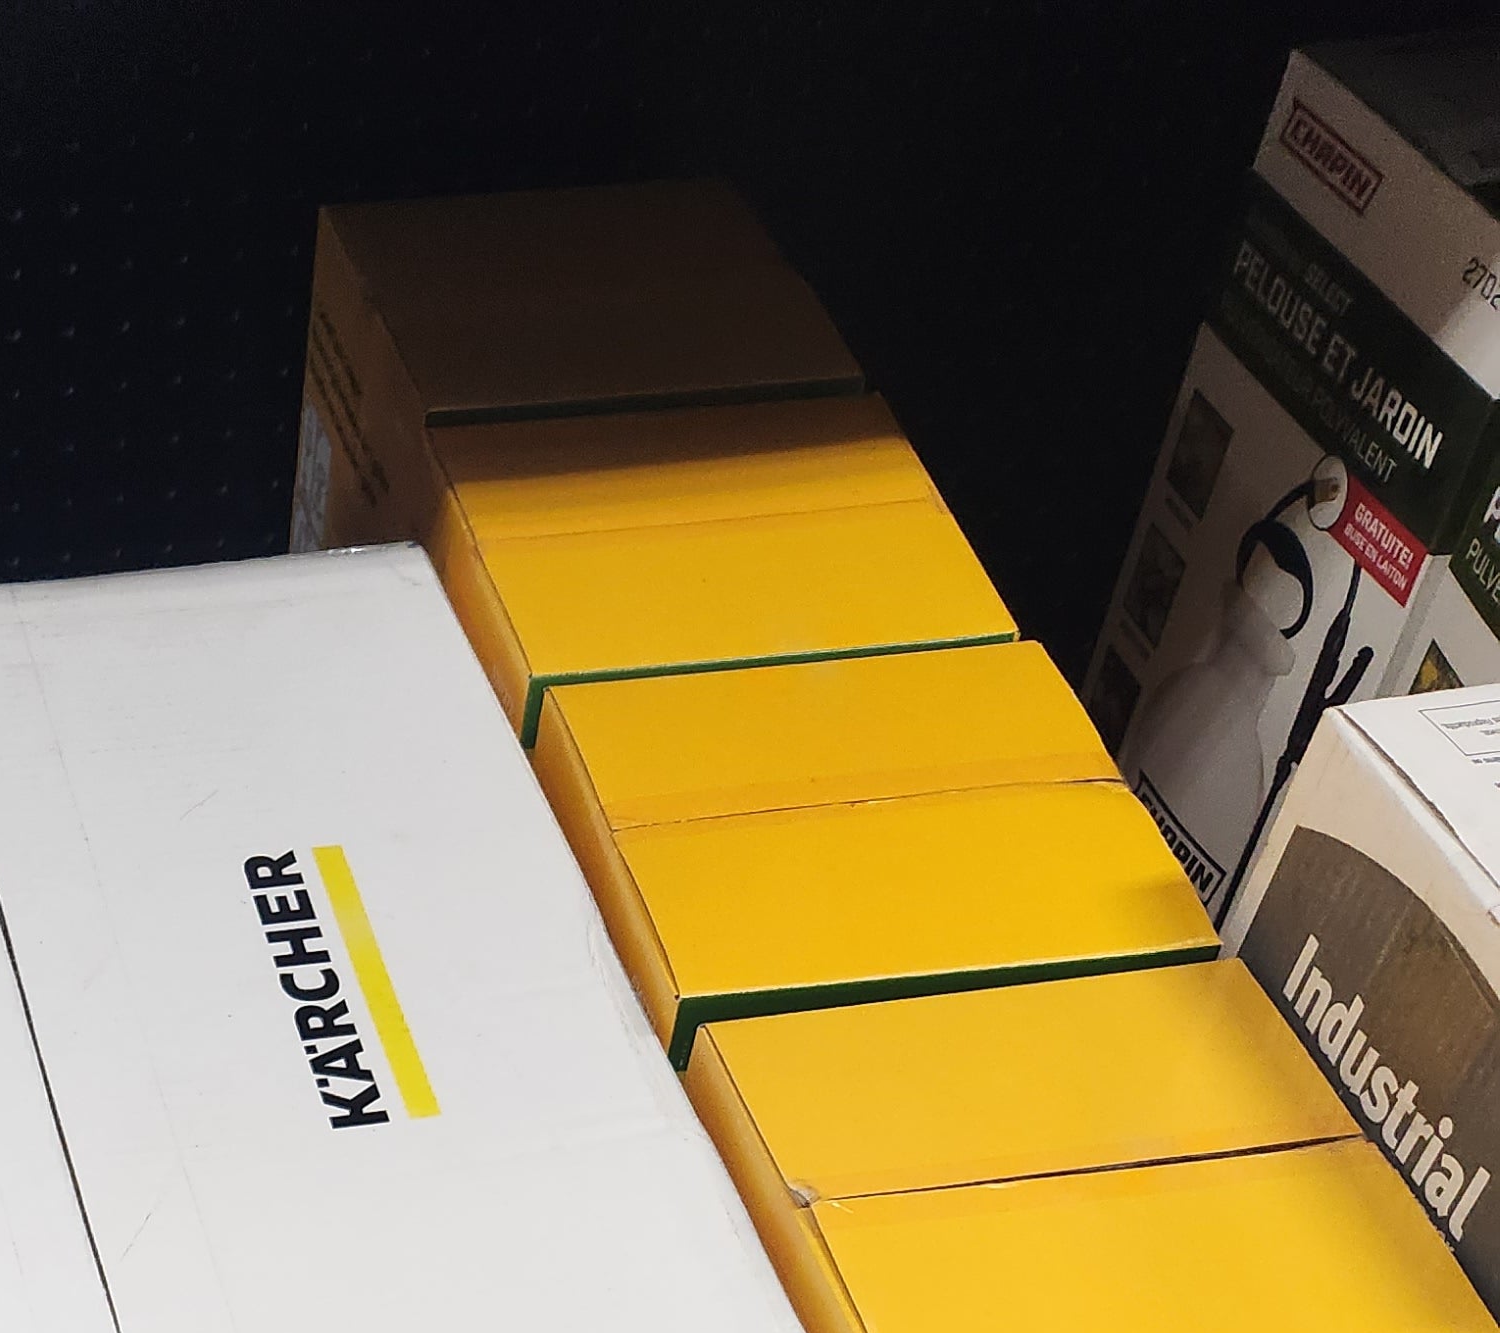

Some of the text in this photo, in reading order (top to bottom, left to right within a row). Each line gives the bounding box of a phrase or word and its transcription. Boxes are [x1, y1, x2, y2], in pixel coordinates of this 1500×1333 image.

[1290, 113, 1370, 198] CHAPIN
[1233, 239, 1444, 469] PELOUSE ET JARDIN
[1355, 502, 1414, 570] GRATUITE!
[1376, 555, 1407, 591] LAITON
[243, 849, 391, 1130] KÄRCHER
[1282, 934, 1492, 1242] Industrial
